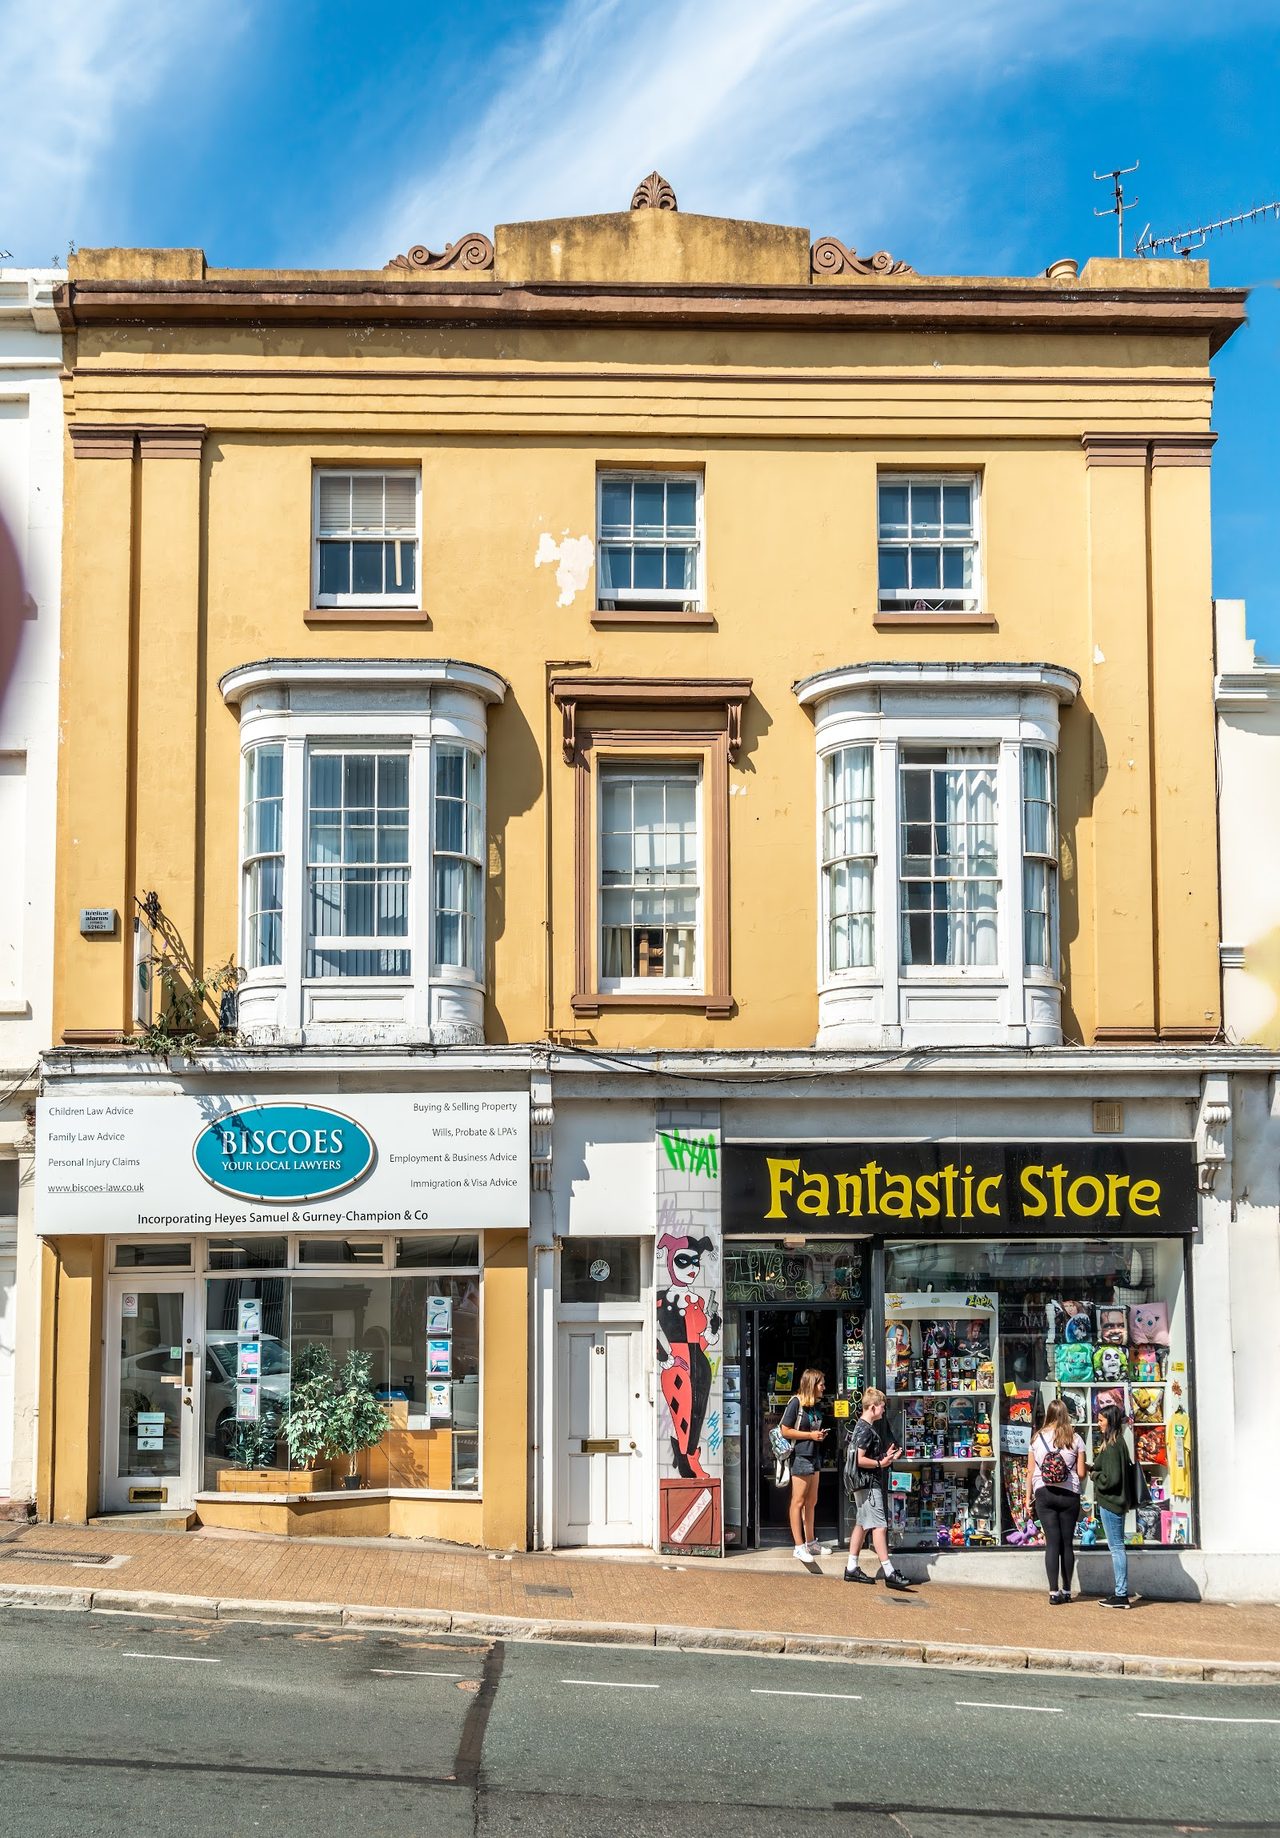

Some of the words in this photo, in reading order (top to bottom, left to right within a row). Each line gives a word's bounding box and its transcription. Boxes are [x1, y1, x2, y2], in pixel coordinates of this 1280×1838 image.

[48, 1107, 85, 1116] Children
[86, 1107, 104, 1116] Law
[105, 1106, 134, 1116] Advice
[413, 1102, 442, 1113] Buying
[443, 1102, 451, 1111] &
[452, 1102, 479, 1113] Selling
[481, 1102, 518, 1113] Property
[48, 1132, 76, 1144] Family
[77, 1132, 96, 1142] Law
[97, 1131, 126, 1141] Advice
[431, 1127, 454, 1138] Wills,
[455, 1127, 488, 1137] Probate
[488, 1127, 496, 1136] &
[497, 1127, 518, 1136] LPA's
[221, 1129, 344, 1155] BISCOES
[48, 1157, 85, 1167] Personal
[86, 1157, 111, 1169] Injury
[112, 1157, 141, 1167] Claims
[389, 1153, 443, 1164] Employment
[443, 1153, 451, 1162] &
[452, 1152, 488, 1162] Business
[489, 1152, 518, 1162] Advice
[222, 1161, 253, 1171] YOUR
[256, 1161, 290, 1170] LOCAL
[294, 1160, 341, 1170] LAWYERS
[48, 1182, 145, 1193] www.biscoes-law.co.uk
[410, 1178, 462, 1190] Immigration
[463, 1178, 470, 1187] &
[471, 1178, 488, 1187] Visa
[489, 1178, 518, 1187] Advice
[764, 1158, 1003, 1219] Fantastic
[1020, 1163, 1161, 1217] Store
[137, 1213, 212, 1226] Incorporating
[214, 1213, 247, 1225] Heyes
[249, 1212, 289, 1223] Samuel
[291, 1212, 300, 1222] &
[302, 1211, 401, 1224] Gurney-Champion
[403, 1211, 412, 1221] &
[414, 1210, 428, 1220] Co
[595, 1346, 605, 1355] 68
